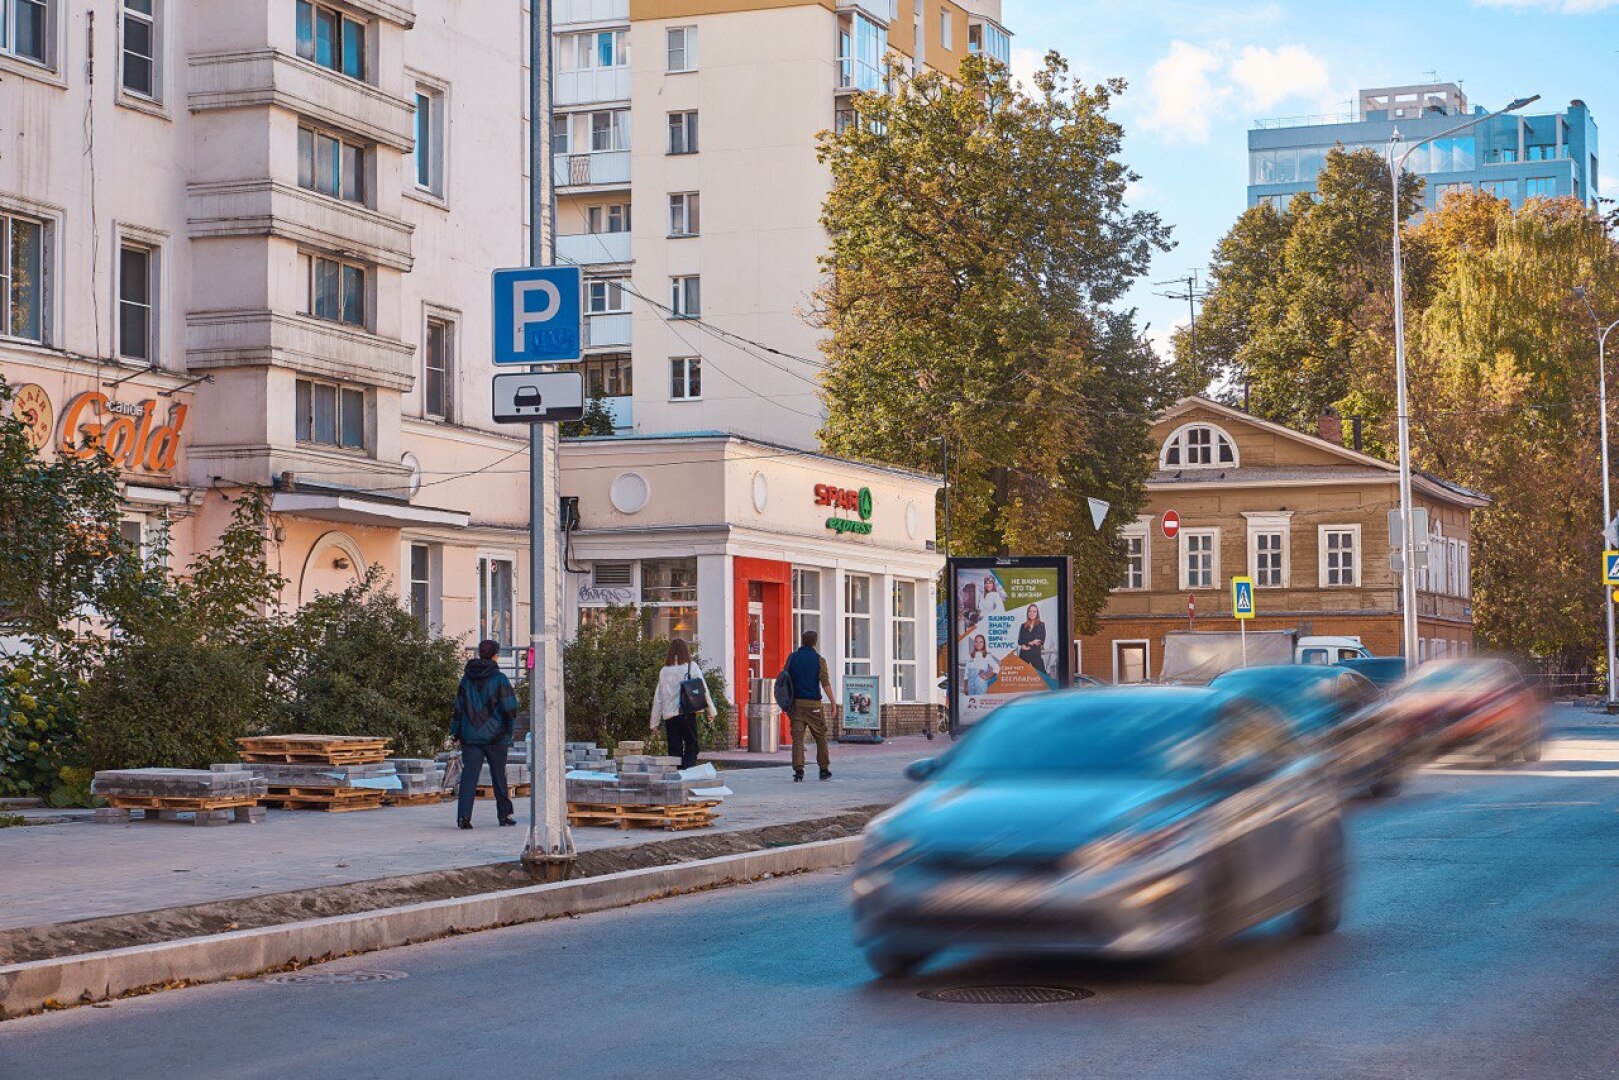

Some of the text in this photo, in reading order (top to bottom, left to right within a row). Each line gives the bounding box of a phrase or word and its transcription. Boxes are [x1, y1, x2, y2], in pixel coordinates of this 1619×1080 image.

[513, 279, 561, 353] P
[108, 400, 144, 416] салон
[57, 391, 188, 470] Gold
[814, 483, 859, 511] SPAR
[826, 517, 873, 535] express
